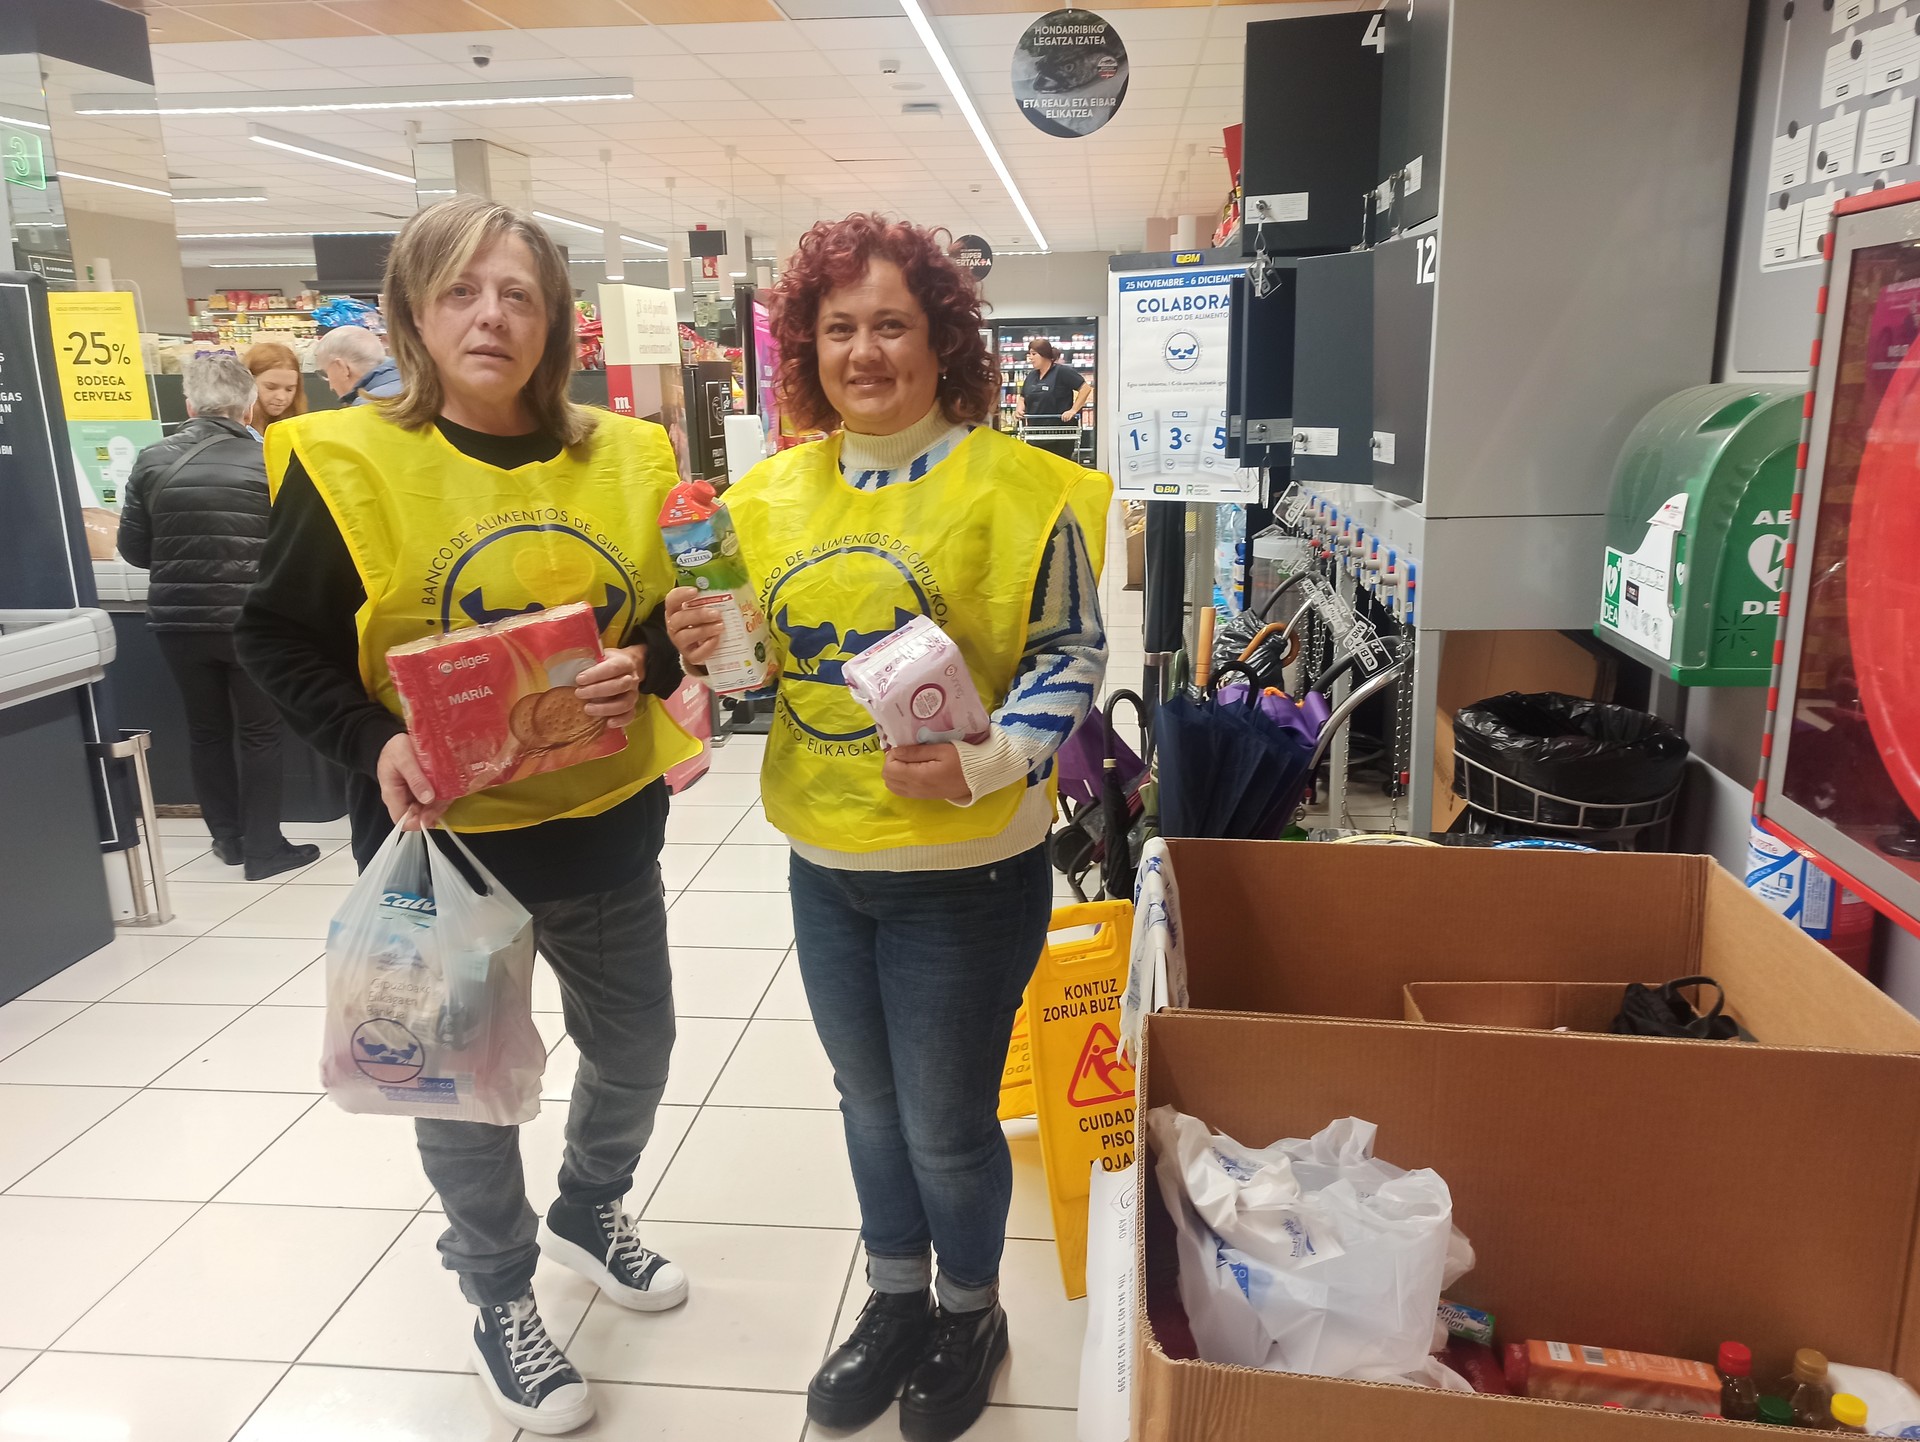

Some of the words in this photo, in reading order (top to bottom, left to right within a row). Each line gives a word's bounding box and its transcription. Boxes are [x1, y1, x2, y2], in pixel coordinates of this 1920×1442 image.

[1034, 25, 1105, 35] HONDARRIBIKO
[1361, 14, 1385, 54] 4
[1034, 37, 1073, 46] LEGATZA
[1075, 36, 1106, 45] IZATEA
[1023, 99, 1040, 109] ETA
[1041, 98, 1070, 108] REALA
[1072, 98, 1089, 107] ETA
[1090, 97, 1116, 107] EIBAR
[1046, 108, 1094, 119] ELIKATZEA
[1416, 235, 1437, 284] 12
[1126, 281, 1136, 290] 25
[1136, 278, 1185, 289] NOVIEMBRE
[1191, 277, 1197, 285] 6
[1137, 294, 1230, 313] COLABORA
[1160, 314, 1183, 322] BANCO
[1185, 313, 1194, 321] DE
[1195, 312, 1229, 320] ALIMENTO
[63, 331, 131, 365] -25%
[77, 375, 126, 386] BODEGA
[74, 391, 132, 402] CERVEZAS
[421, 546, 454, 606] BANCO
[450, 530, 472, 550] DE
[475, 507, 569, 535] ALIMENTOS
[573, 516, 592, 535] DE
[595, 533, 645, 606] GIPUZKOA
[759, 566, 781, 614] ANCO
[785, 549, 805, 567] DE
[810, 532, 890, 556] ALIMENTOS
[889, 539, 911, 554] DE
[907, 552, 949, 628] GIPUZKOA
[1604, 605, 1619, 624] DEA
[454, 653, 490, 670] eliges
[448, 684, 494, 706] MARÍA
[807, 737, 882, 758] ELIKAGAI
[381, 892, 437, 911] Calv
[1064, 978, 1118, 1001] KONTUZ
[1043, 1002, 1088, 1023] ZORUA
[1079, 1108, 1136, 1133] CUIDAD
[1101, 1131, 1135, 1150] PISO
[1441, 1306, 1468, 1321] Triple
